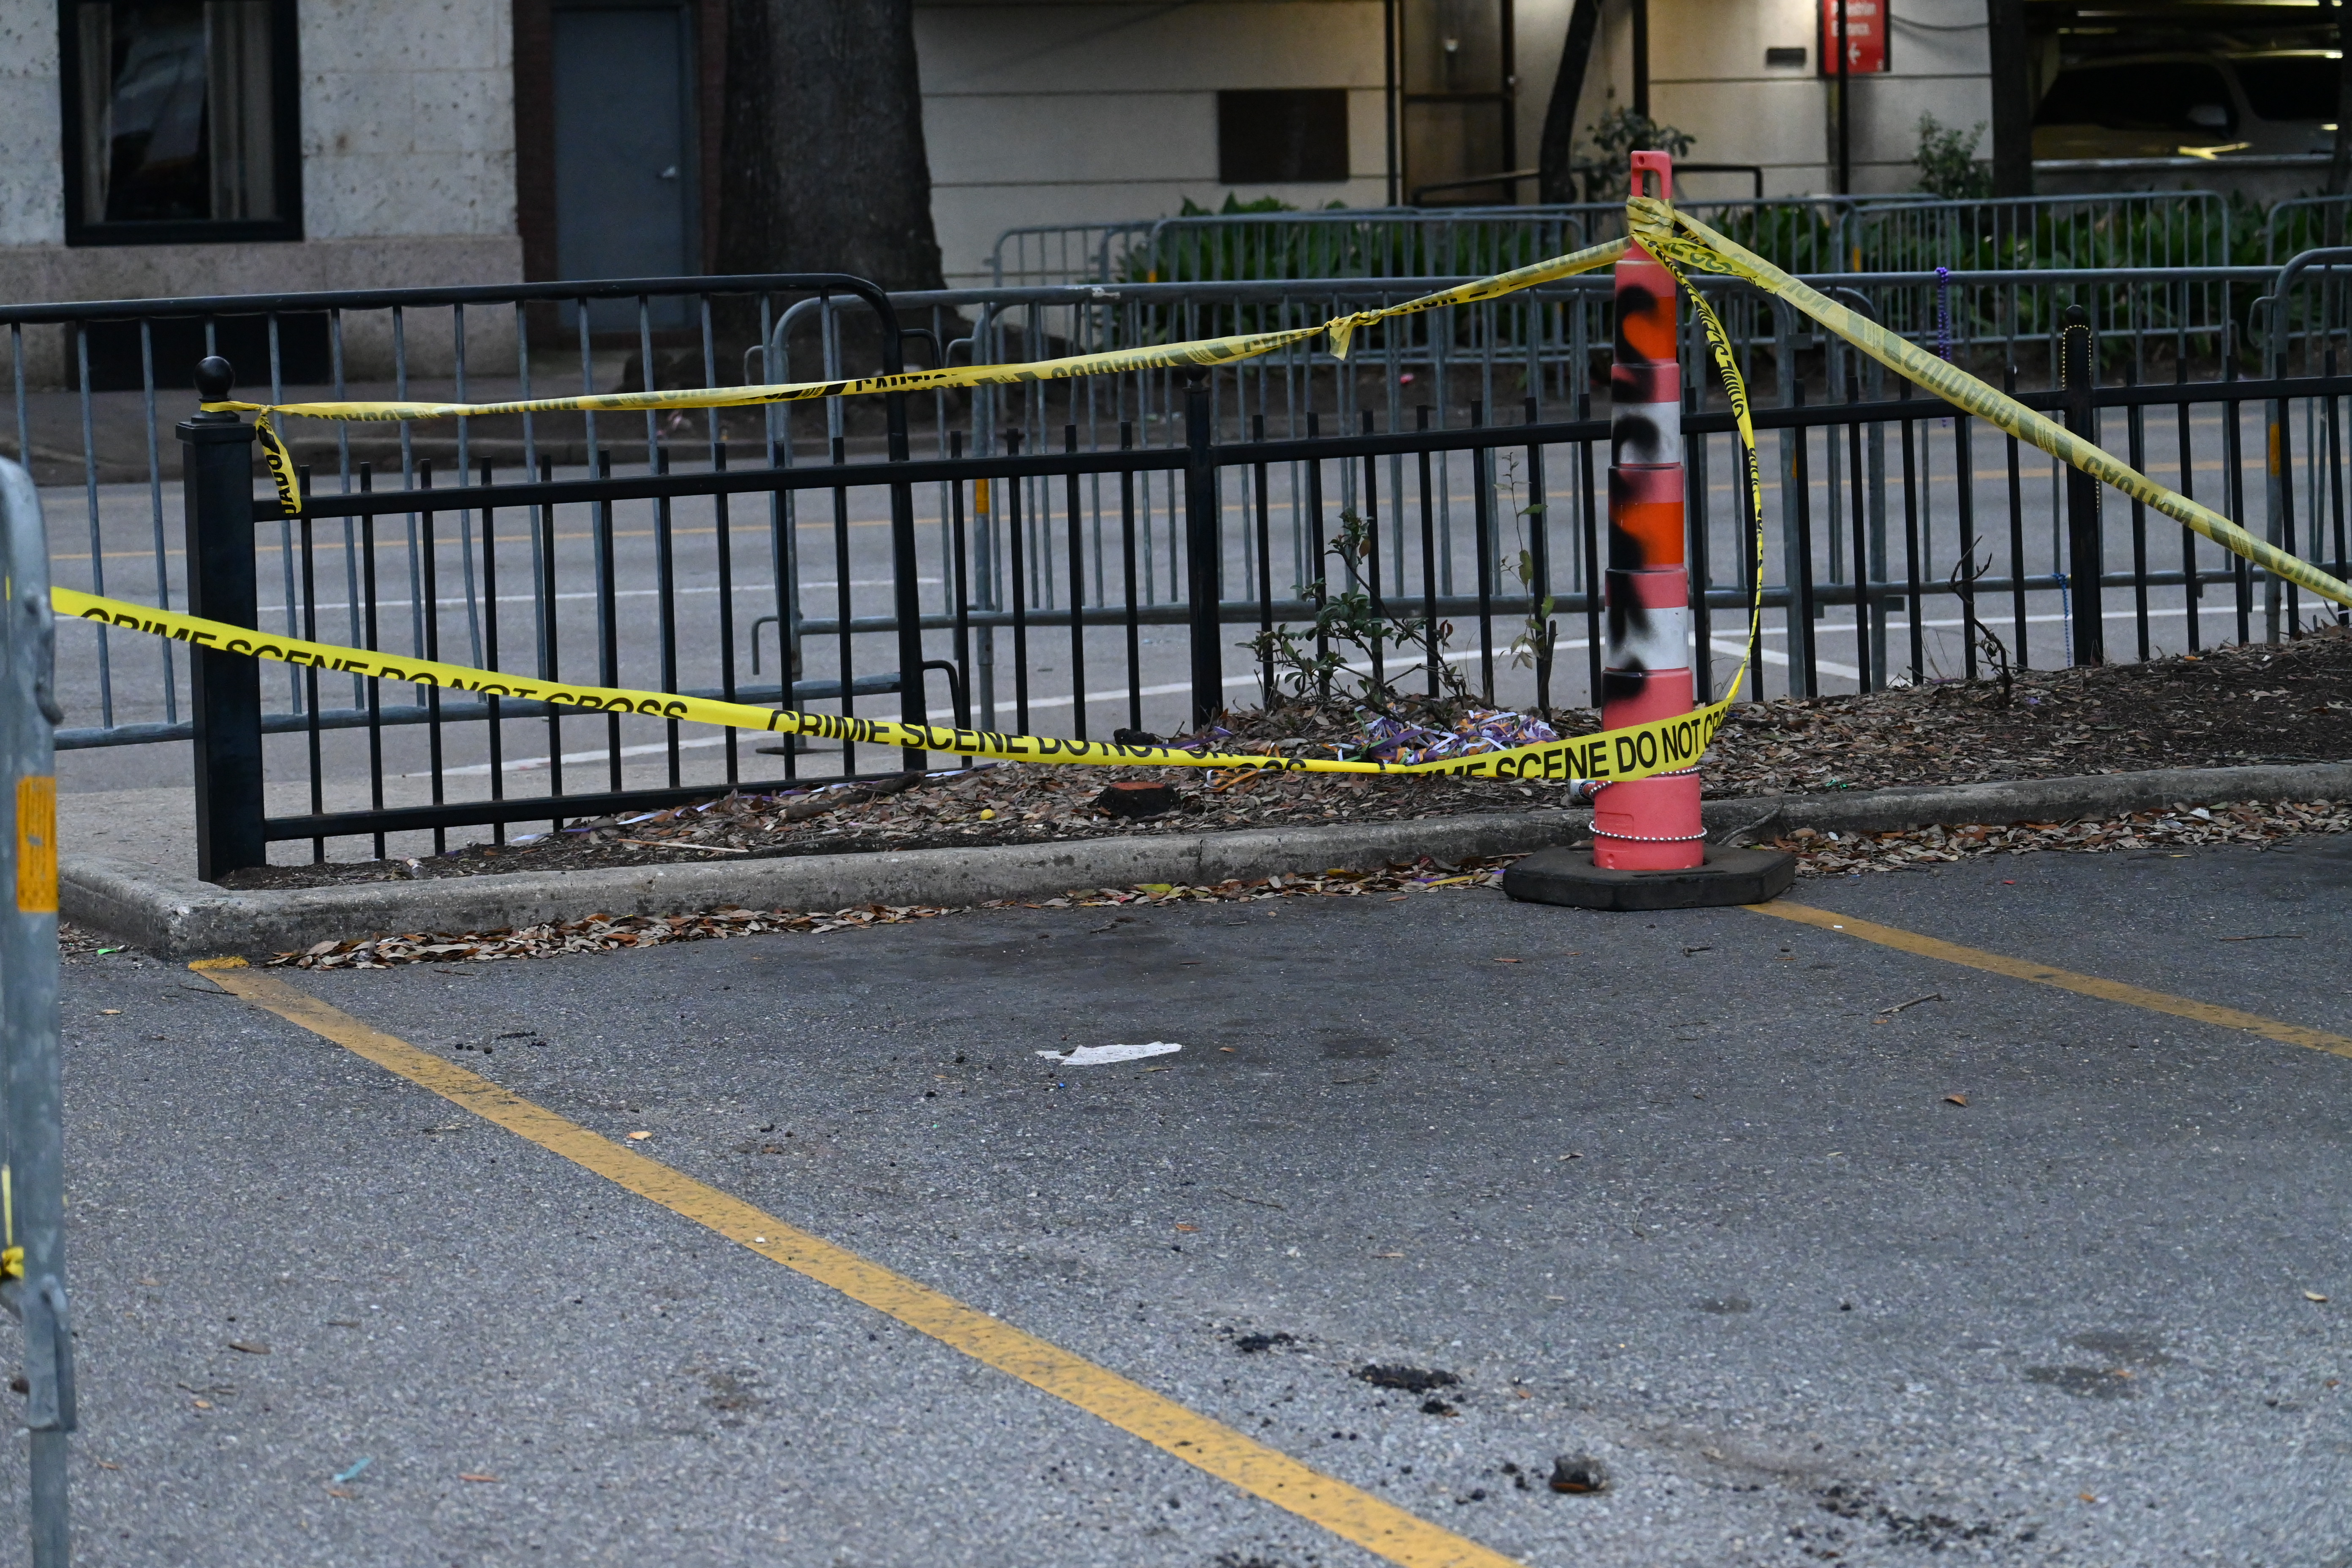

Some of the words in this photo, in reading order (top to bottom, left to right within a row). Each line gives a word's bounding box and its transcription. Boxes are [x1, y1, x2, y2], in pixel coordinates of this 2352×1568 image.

[768, 710, 890, 744] CRIME
[901, 723, 1029, 754] SCENE
[1496, 740, 1610, 779] SCENE
[1616, 731, 1657, 773] DO
[1661, 718, 1701, 763] NOT
